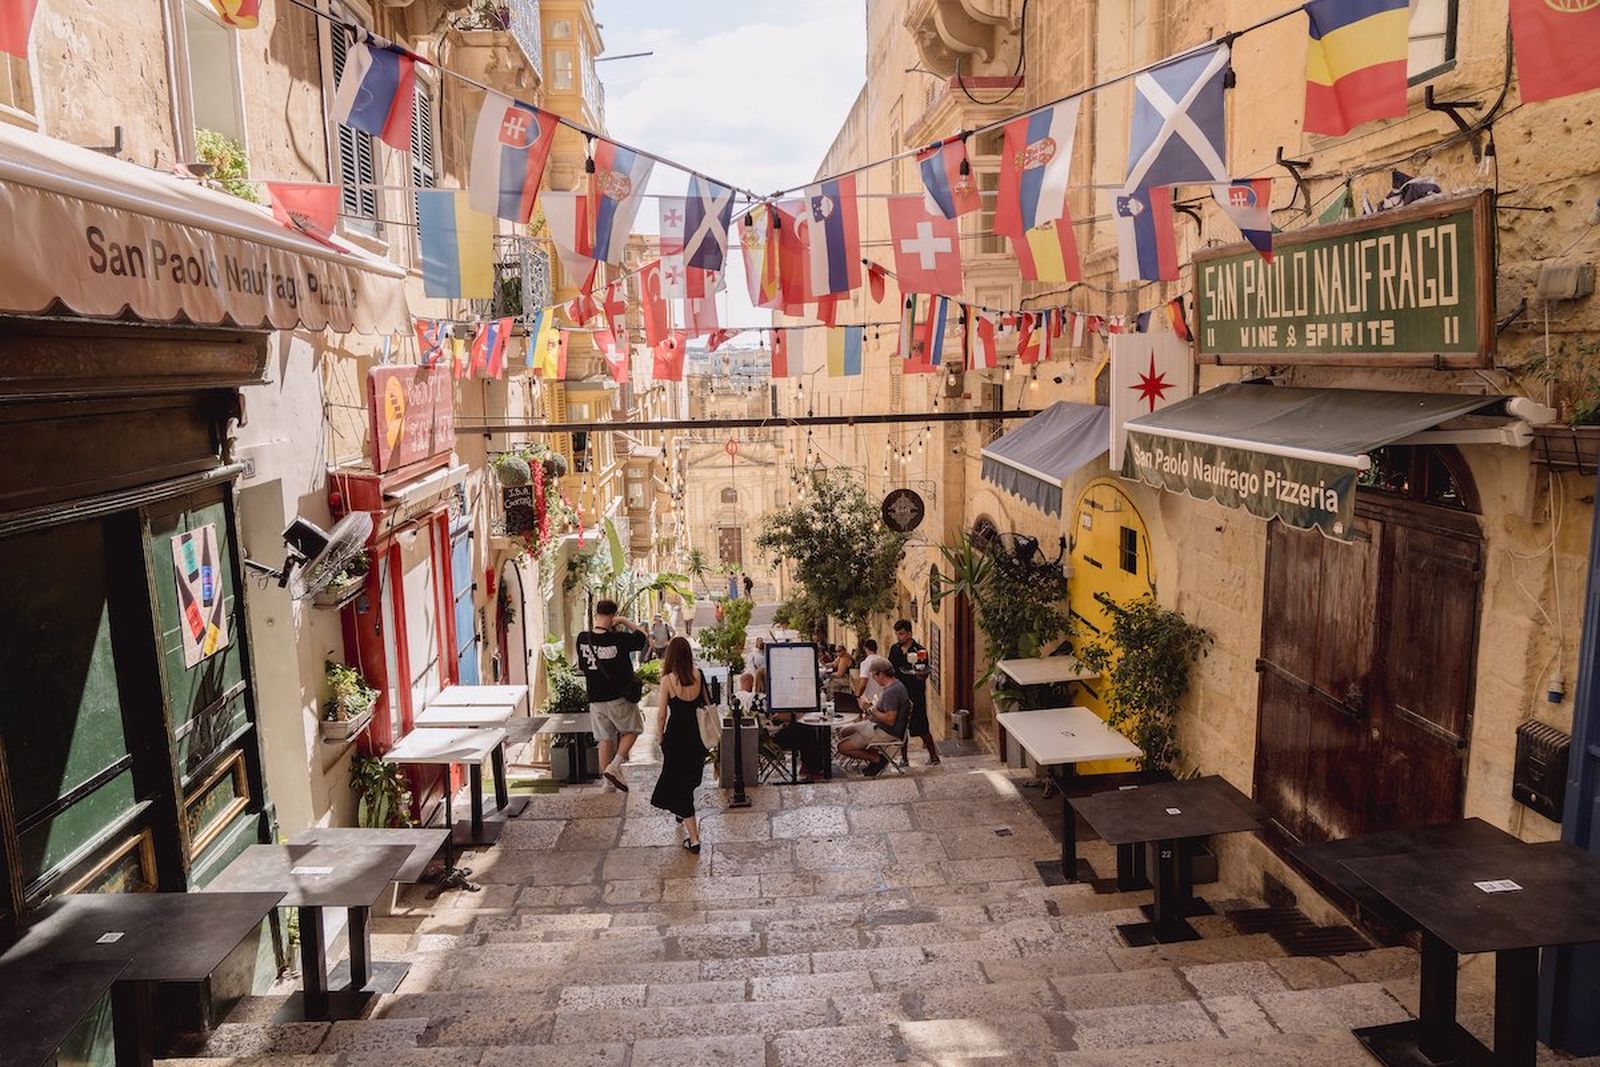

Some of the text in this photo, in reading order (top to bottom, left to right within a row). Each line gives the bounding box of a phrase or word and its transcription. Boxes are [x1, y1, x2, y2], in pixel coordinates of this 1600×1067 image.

[86, 226, 146, 279] San
[151, 239, 219, 289] Paolo
[224, 255, 304, 309] Naufag
[1205, 223, 1459, 321] SAN PAOLO NAUFRAGO
[1241, 325, 1278, 347] WINE
[1286, 324, 1297, 347] &
[1306, 320, 1395, 347] SPIRITS
[1134, 444, 1339, 513] San Paolo Naufrago Pizzeria
[1161, 850, 1172, 859] 22
